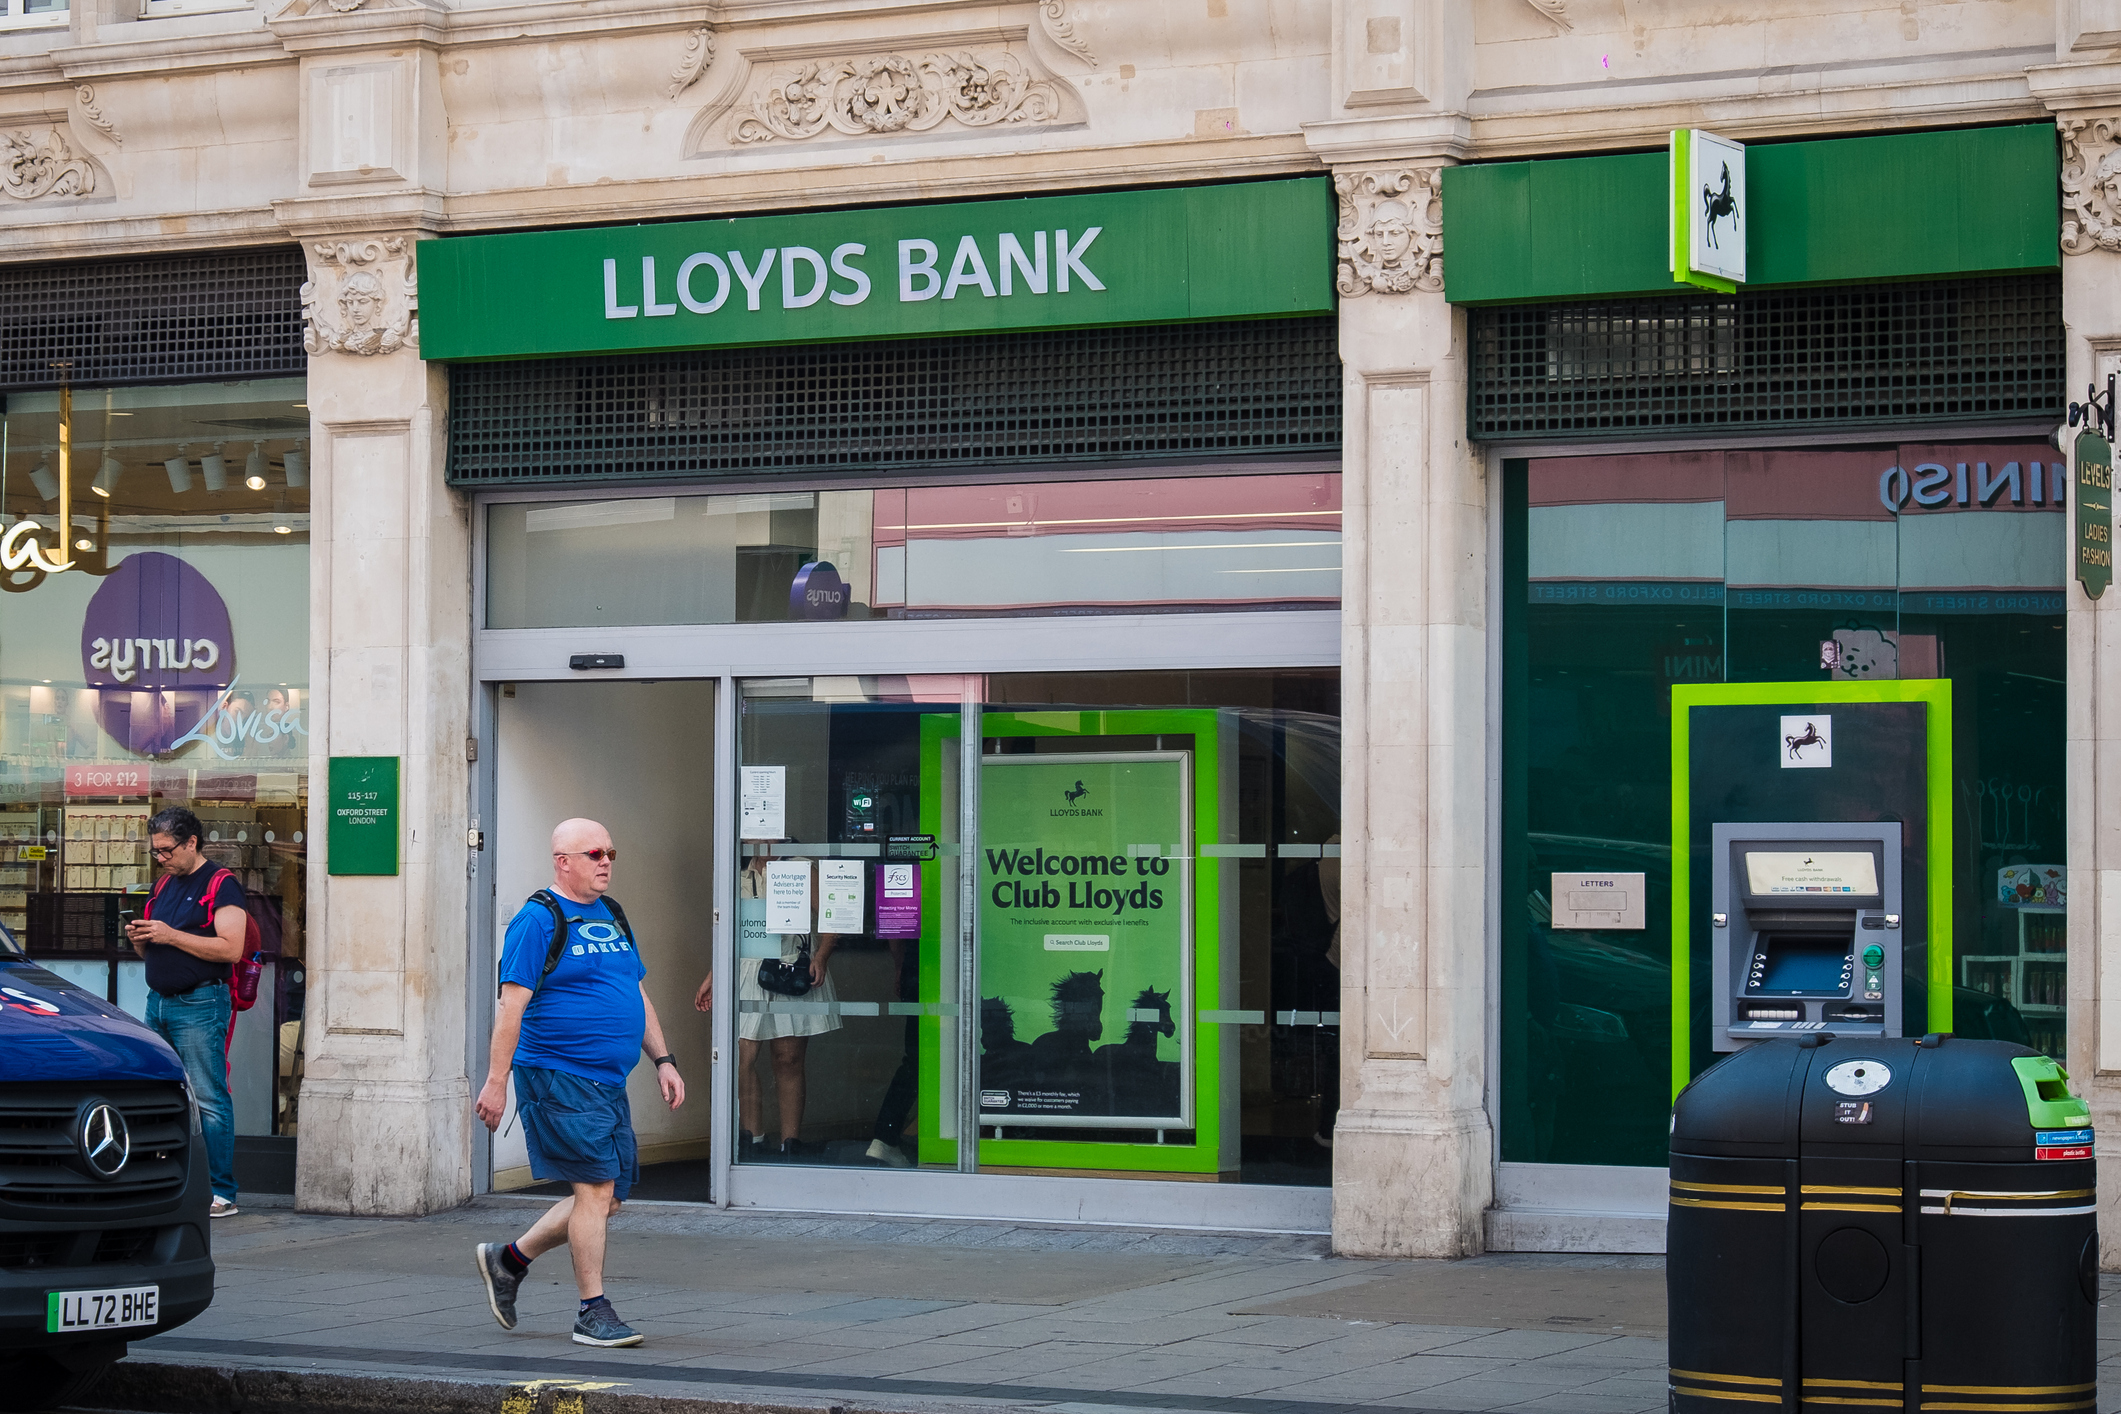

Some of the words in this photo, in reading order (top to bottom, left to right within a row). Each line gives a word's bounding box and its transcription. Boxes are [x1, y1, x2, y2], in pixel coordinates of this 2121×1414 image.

[603, 243, 872, 320] LLOYDS
[898, 226, 1107, 303] BANK
[2080, 460, 2111, 490] LEVELS
[2084, 522, 2108, 543] LADIES
[2082, 546, 2111, 568] FASHION
[171, 673, 309, 761] Lovisa
[74, 772, 82, 787] 3
[86, 772, 112, 787] FOR
[116, 772, 138, 787] £12
[909, 775, 920, 787] FO
[347, 792, 378, 801] 115-117
[337, 808, 364, 816] OXFORD
[364, 808, 388, 816] STREET
[1050, 809, 1080, 817] LLOYDS
[1081, 808, 1103, 817] BANK
[348, 817, 376, 825] LONDON
[985, 847, 1128, 876] Welcome
[1134, 854, 1169, 876] to
[781, 873, 806, 881] Mortgage
[991, 880, 1060, 909] Club
[1069, 880, 1163, 915] Lloyds
[1023, 918, 1049, 926] inclusive
[1079, 918, 1093, 926] with
[1093, 918, 1121, 926] exclusive
[743, 929, 767, 939] Doors
[63, 1294, 117, 1327] LL72
[121, 1291, 156, 1322] BHE
